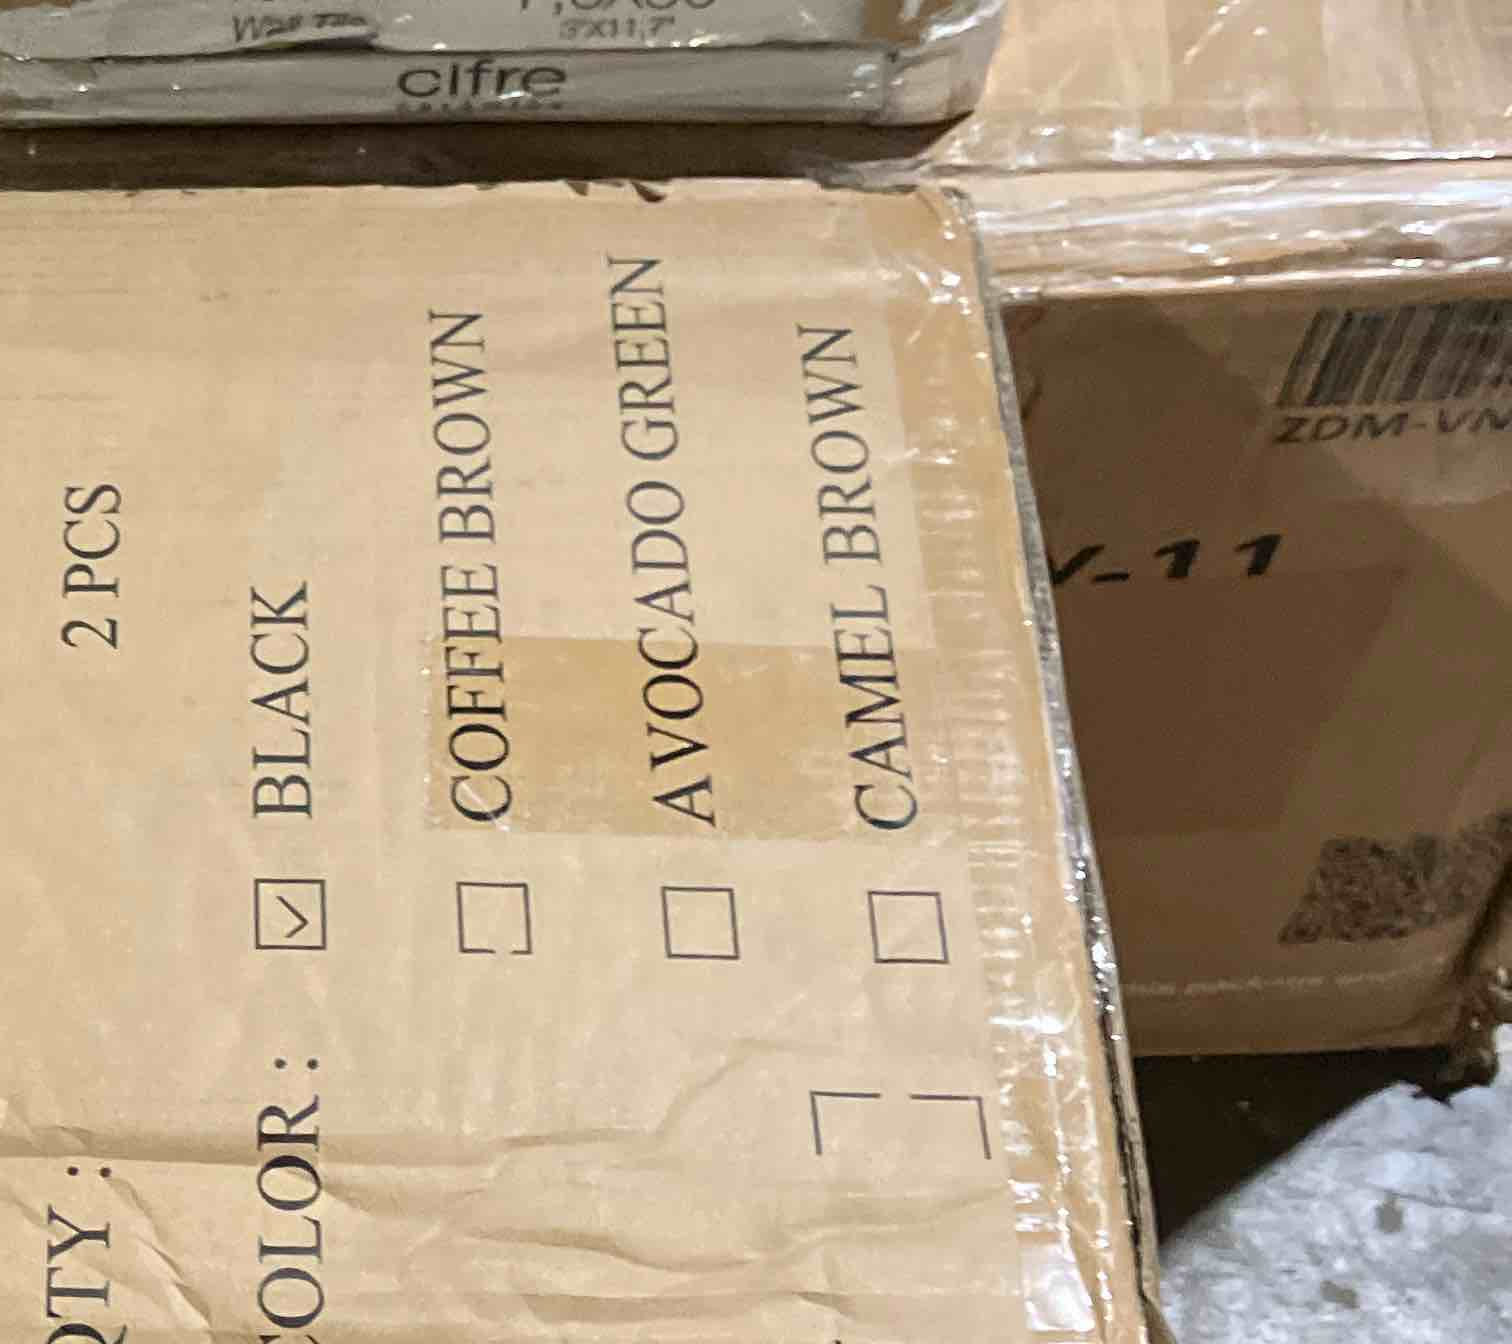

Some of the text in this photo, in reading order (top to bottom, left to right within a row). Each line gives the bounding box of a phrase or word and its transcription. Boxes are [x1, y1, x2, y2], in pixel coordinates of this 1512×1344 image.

[61, 482, 123, 651] 2 PCS
[249, 580, 313, 820] BLACK
[427, 308, 513, 824] COFFEE BROWN
[606, 253, 716, 828] AVOCADO GREEN
[796, 323, 919, 831] CAMEL BROWN
